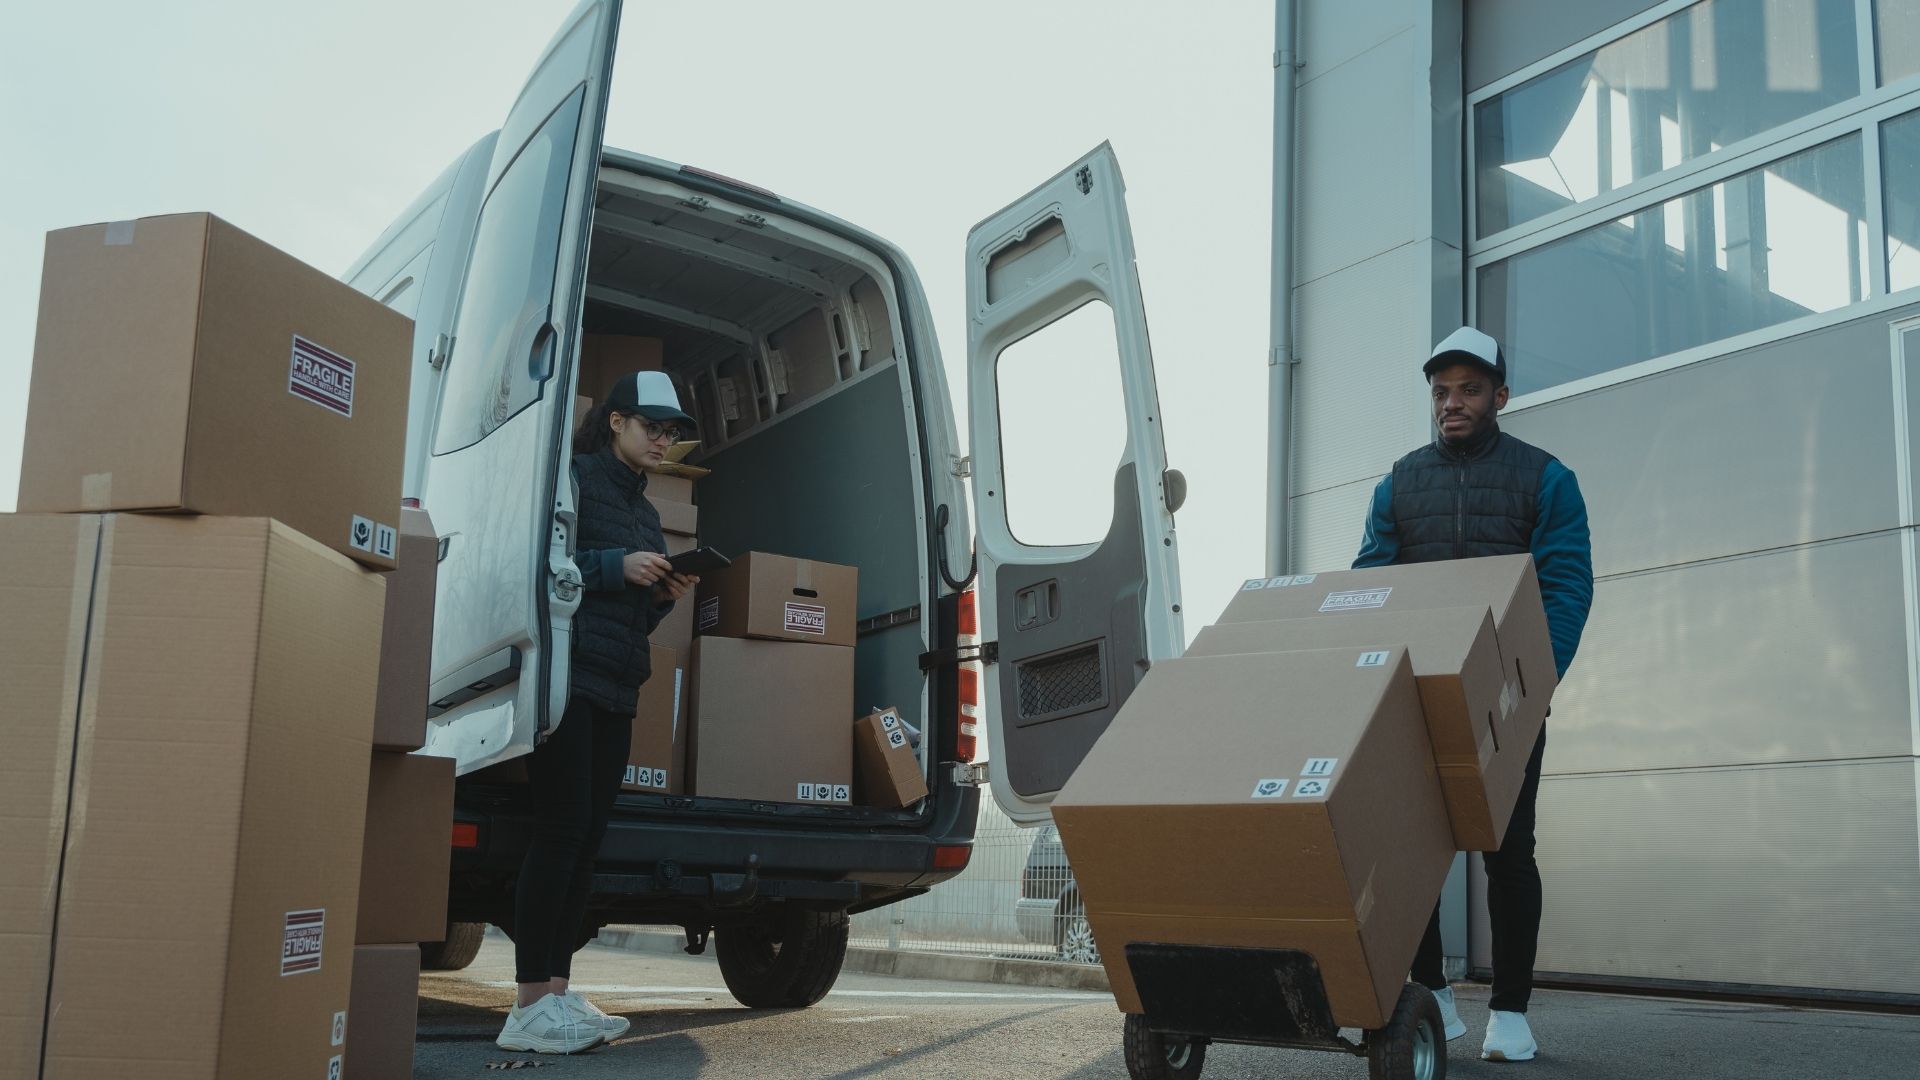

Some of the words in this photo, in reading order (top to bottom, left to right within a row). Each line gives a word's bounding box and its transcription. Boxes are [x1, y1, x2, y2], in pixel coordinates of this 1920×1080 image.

[293, 354, 351, 392] FRAGILE
[293, 369, 318, 386] HANDLE
[318, 380, 334, 393] WITH
[333, 387, 350, 400] CARE
[1326, 593, 1386, 605] FRAGILE
[787, 614, 823, 626] FRAGILE
[284, 935, 321, 955] FRAGILE
